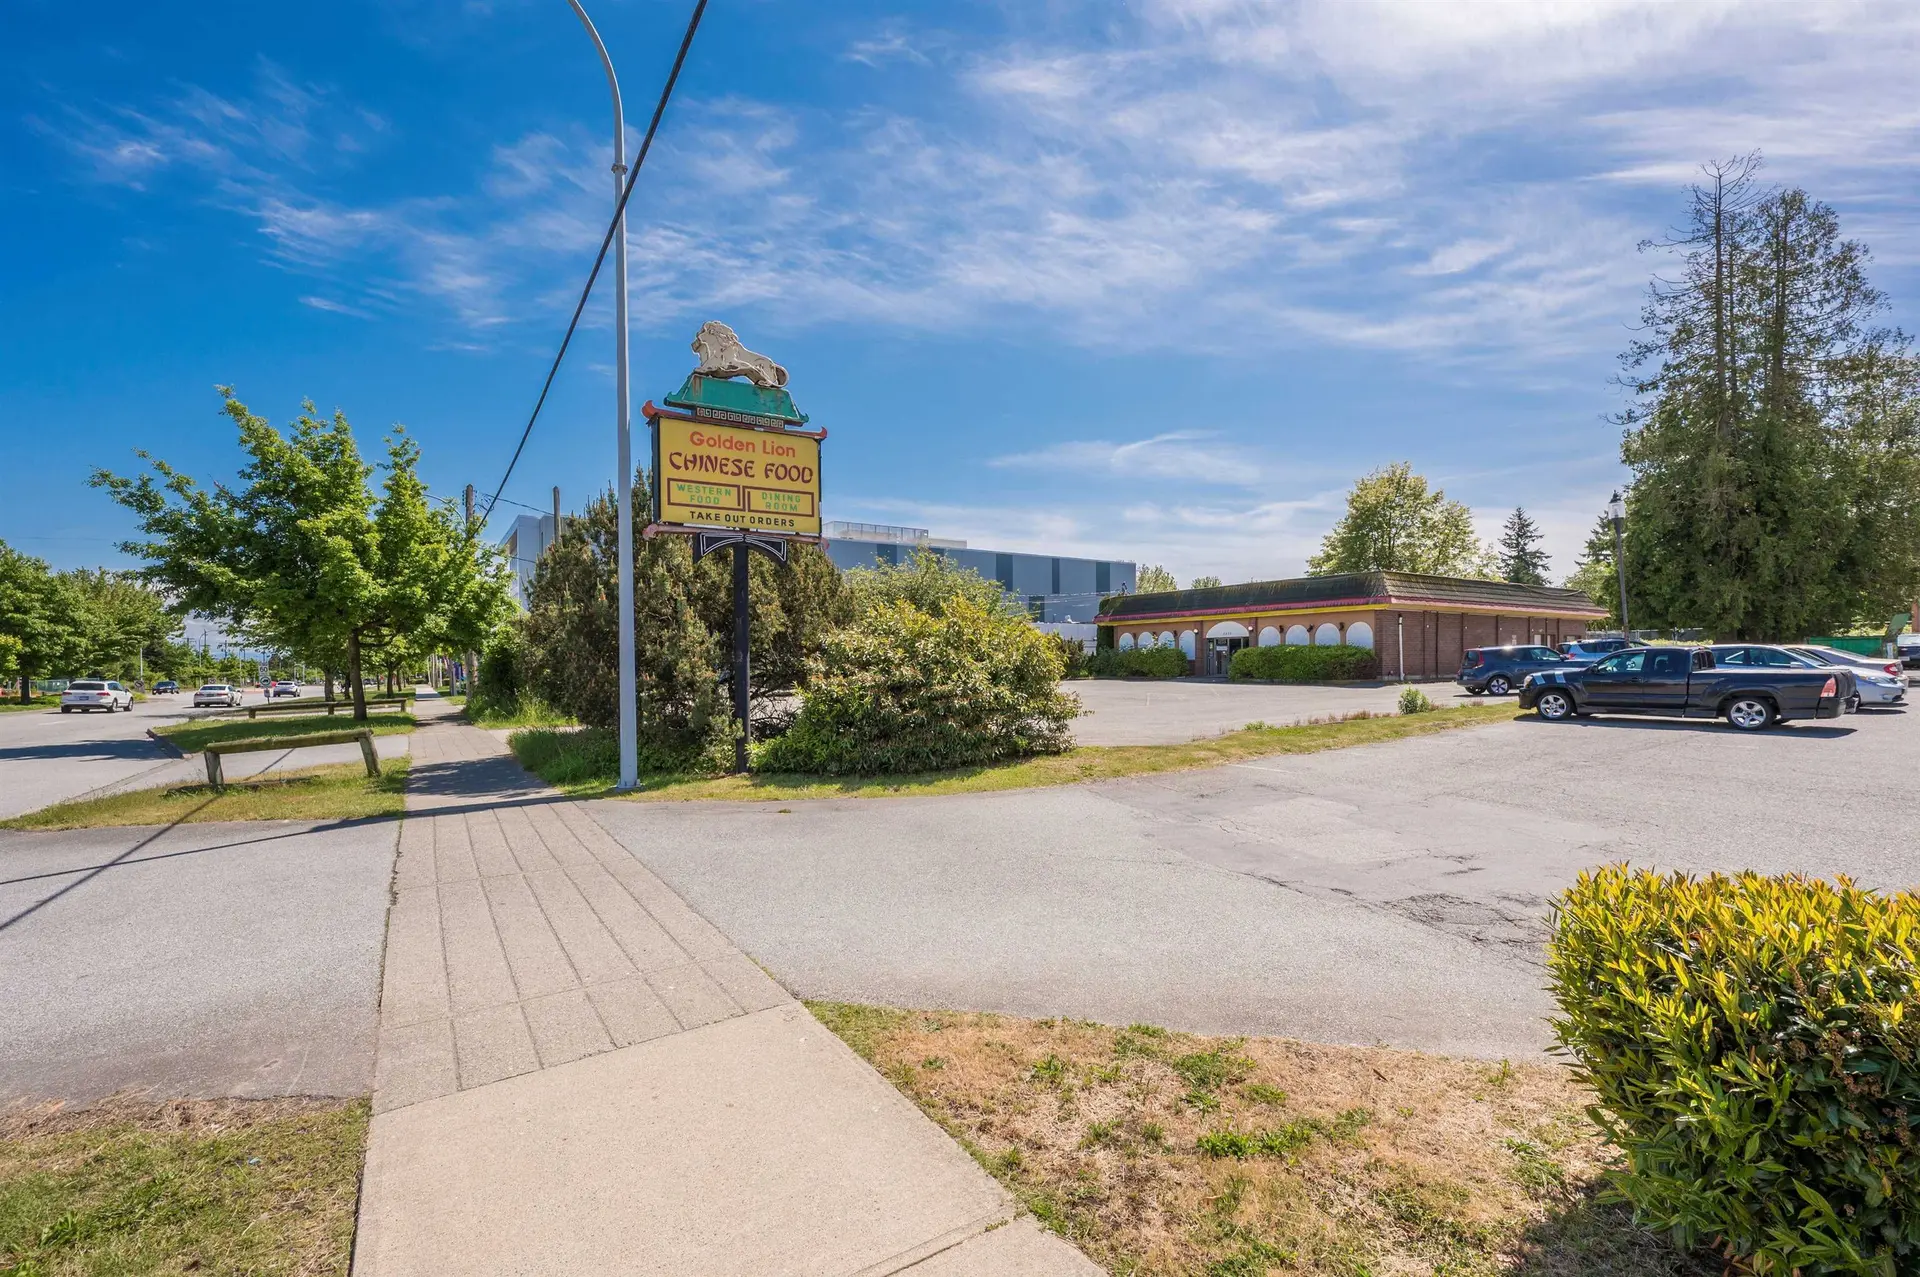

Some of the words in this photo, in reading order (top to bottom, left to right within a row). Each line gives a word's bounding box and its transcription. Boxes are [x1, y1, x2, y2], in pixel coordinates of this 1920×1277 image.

[689, 431, 755, 452] Golden
[762, 440, 796, 457] Lion
[669, 452, 755, 478] CHINESE
[764, 463, 813, 484] FOOD
[676, 483, 731, 496] WESTERN
[689, 495, 720, 505] FOOD
[761, 492, 801, 503] DINING
[765, 502, 798, 512] ROOM
[689, 511, 721, 521] TAKE
[724, 514, 746, 523] OUT
[749, 516, 795, 527] ORDERS
